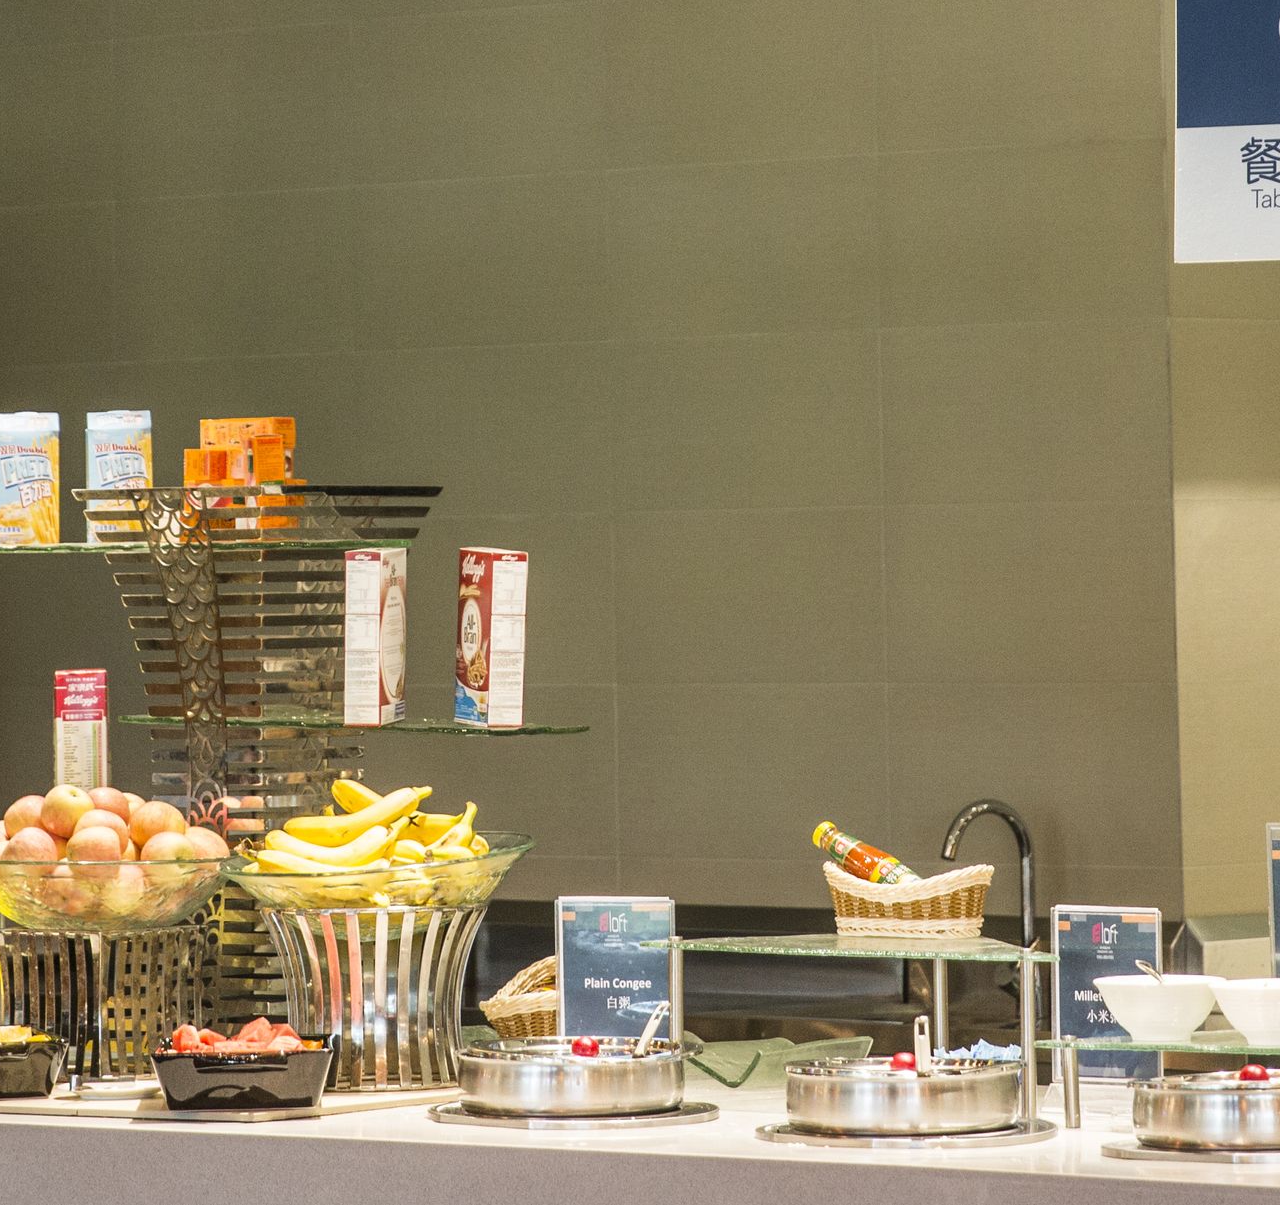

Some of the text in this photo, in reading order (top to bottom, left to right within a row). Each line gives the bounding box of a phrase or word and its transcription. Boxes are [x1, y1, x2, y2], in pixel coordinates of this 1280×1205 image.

[599, 910, 627, 932] aloft
[1091, 921, 1118, 945] aloft
[584, 977, 652, 990] Plain Congee
[607, 996, 631, 1009] 白粥
[1074, 990, 1103, 1002] Millet
